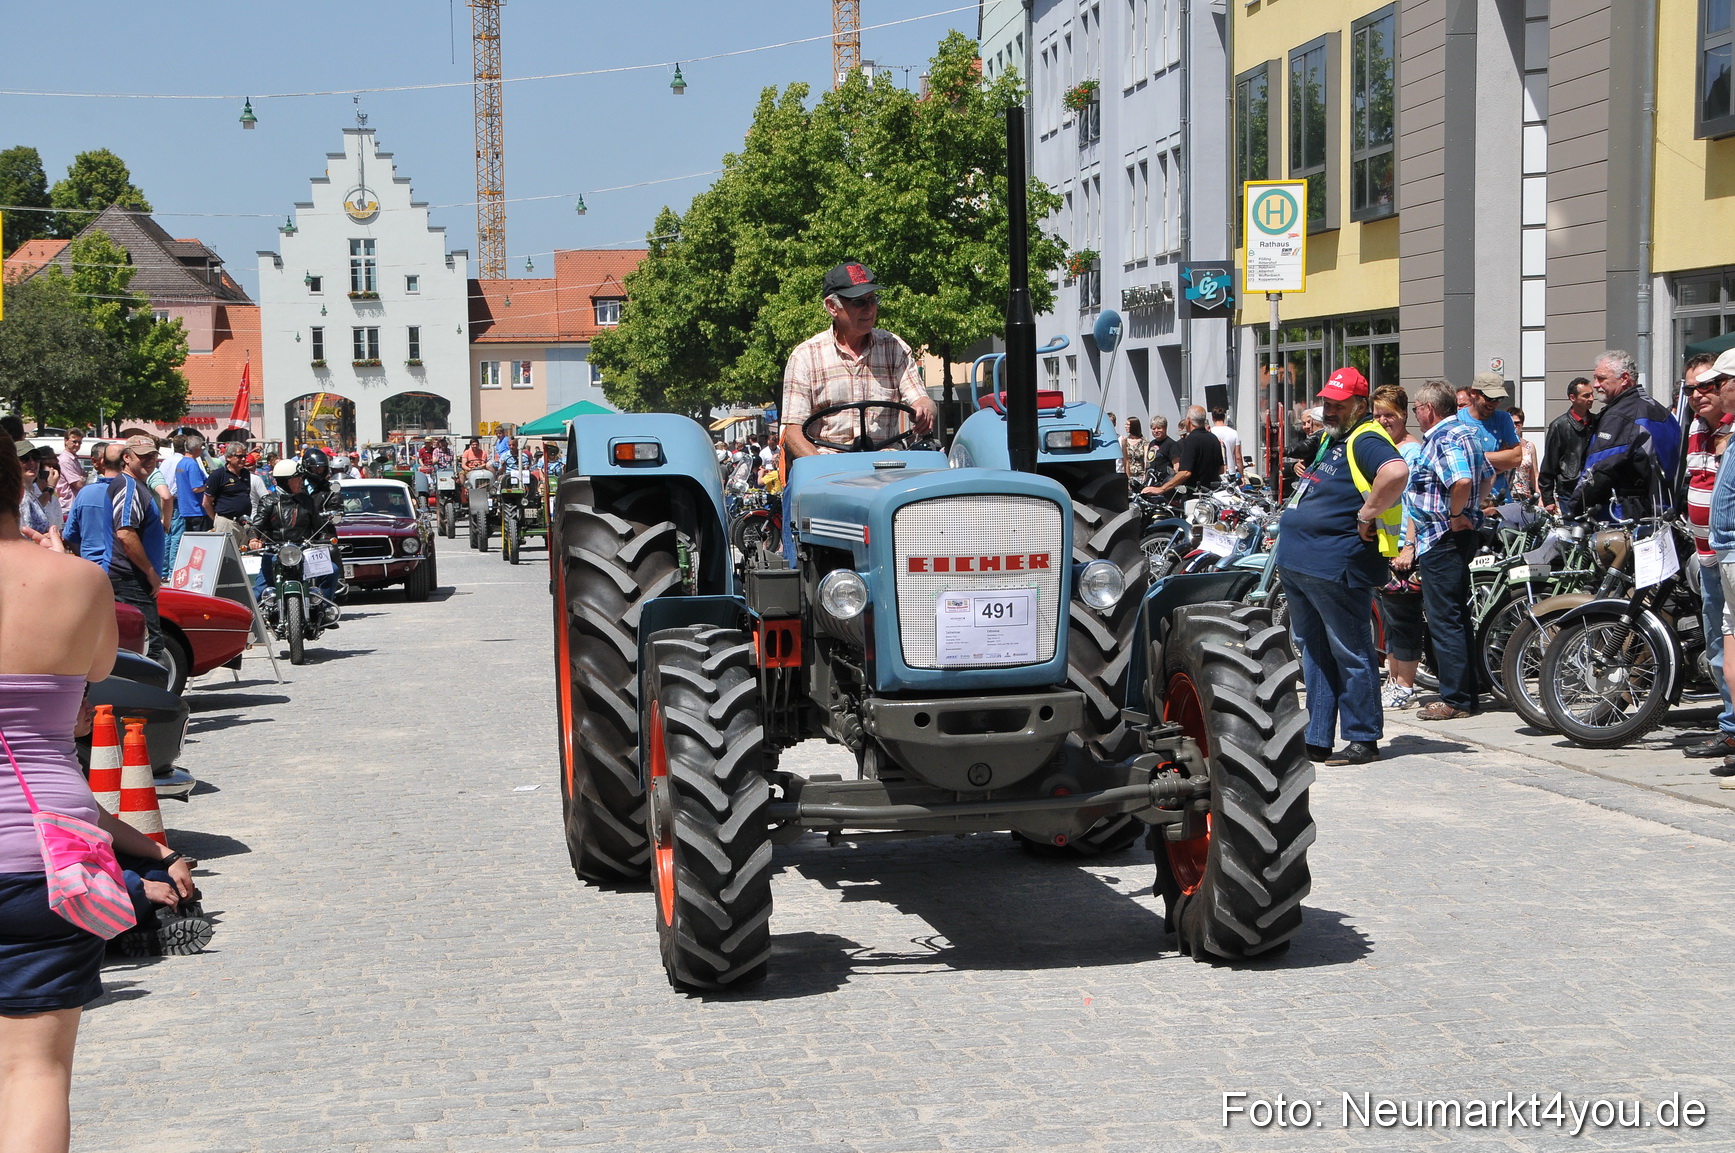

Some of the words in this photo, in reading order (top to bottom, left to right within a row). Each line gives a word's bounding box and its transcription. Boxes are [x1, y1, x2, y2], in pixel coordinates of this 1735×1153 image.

[1266, 199, 1285, 225] H
[1198, 276, 1218, 300] G2
[311, 552, 324, 560] 110
[908, 553, 1050, 572] EICHER
[1475, 557, 1490, 566] 102
[982, 602, 1014, 619] 491
